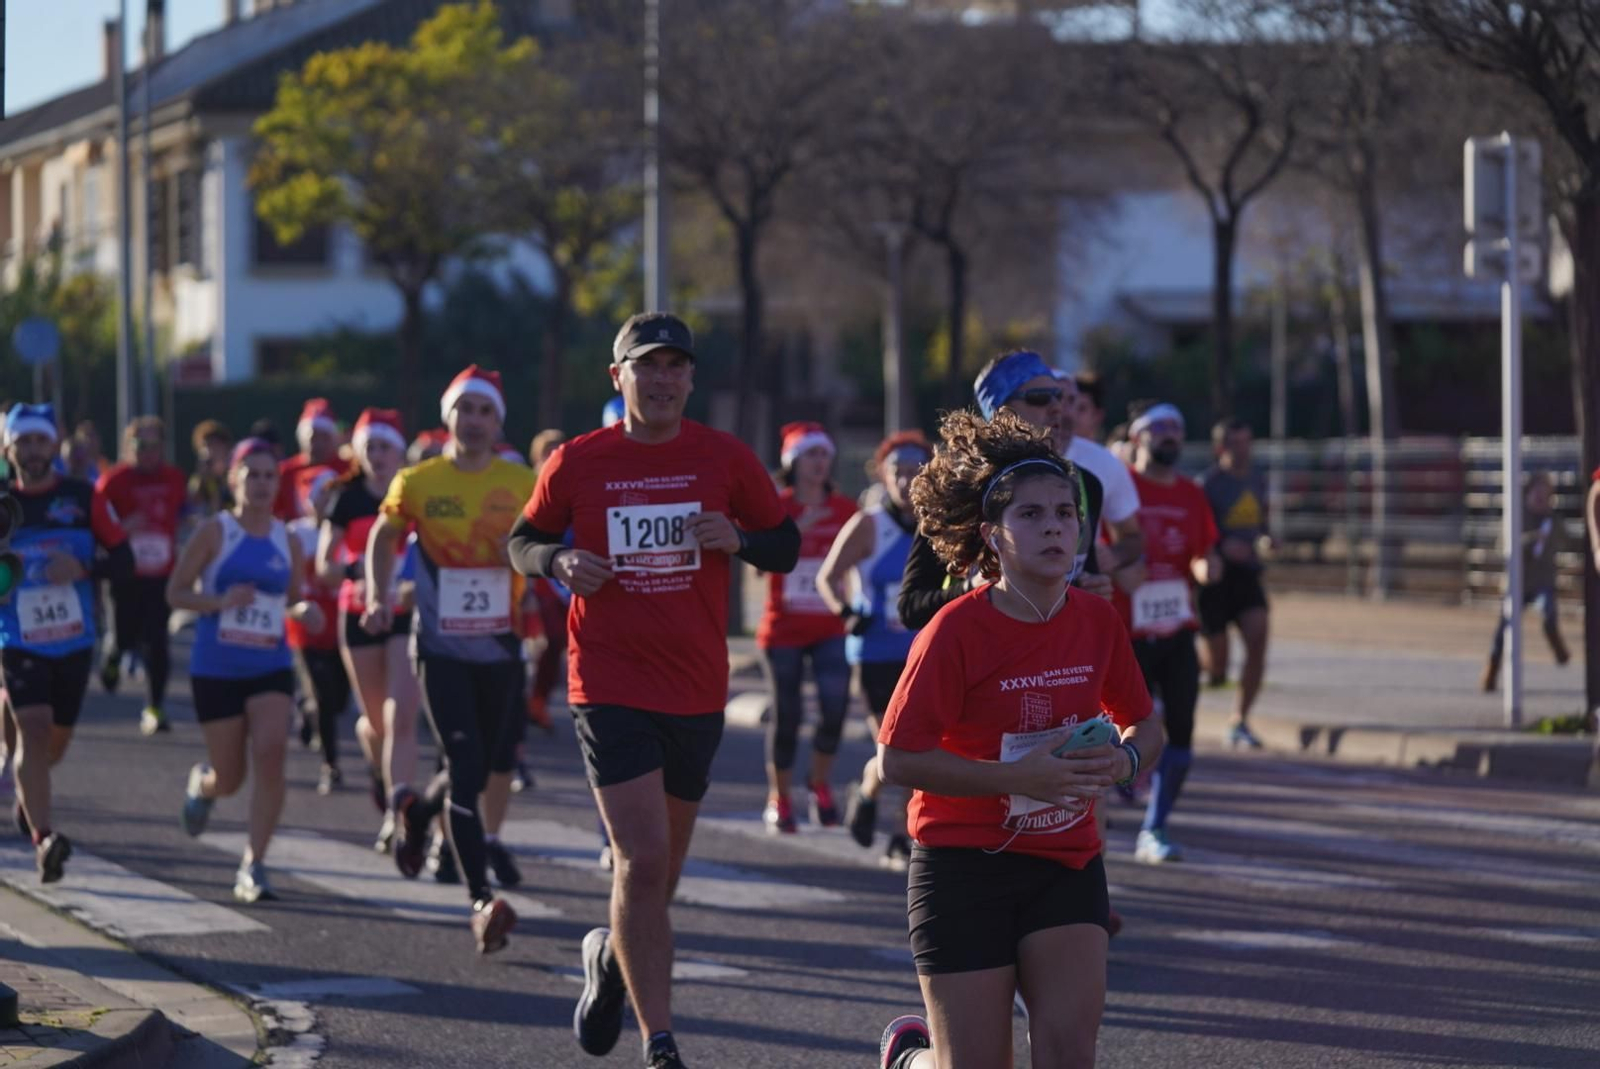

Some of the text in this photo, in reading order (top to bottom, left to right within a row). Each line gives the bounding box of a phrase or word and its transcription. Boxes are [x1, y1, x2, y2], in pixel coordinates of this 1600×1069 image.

[621, 516, 684, 548] 1208
[462, 590, 490, 612] 23
[33, 602, 68, 624] 345
[1044, 665, 1094, 678] SAN SILVESTRE
[1000, 676, 1044, 691] XXXVII
[1045, 676, 1088, 687] CORDOBESA
[1062, 714, 1078, 727] 50
